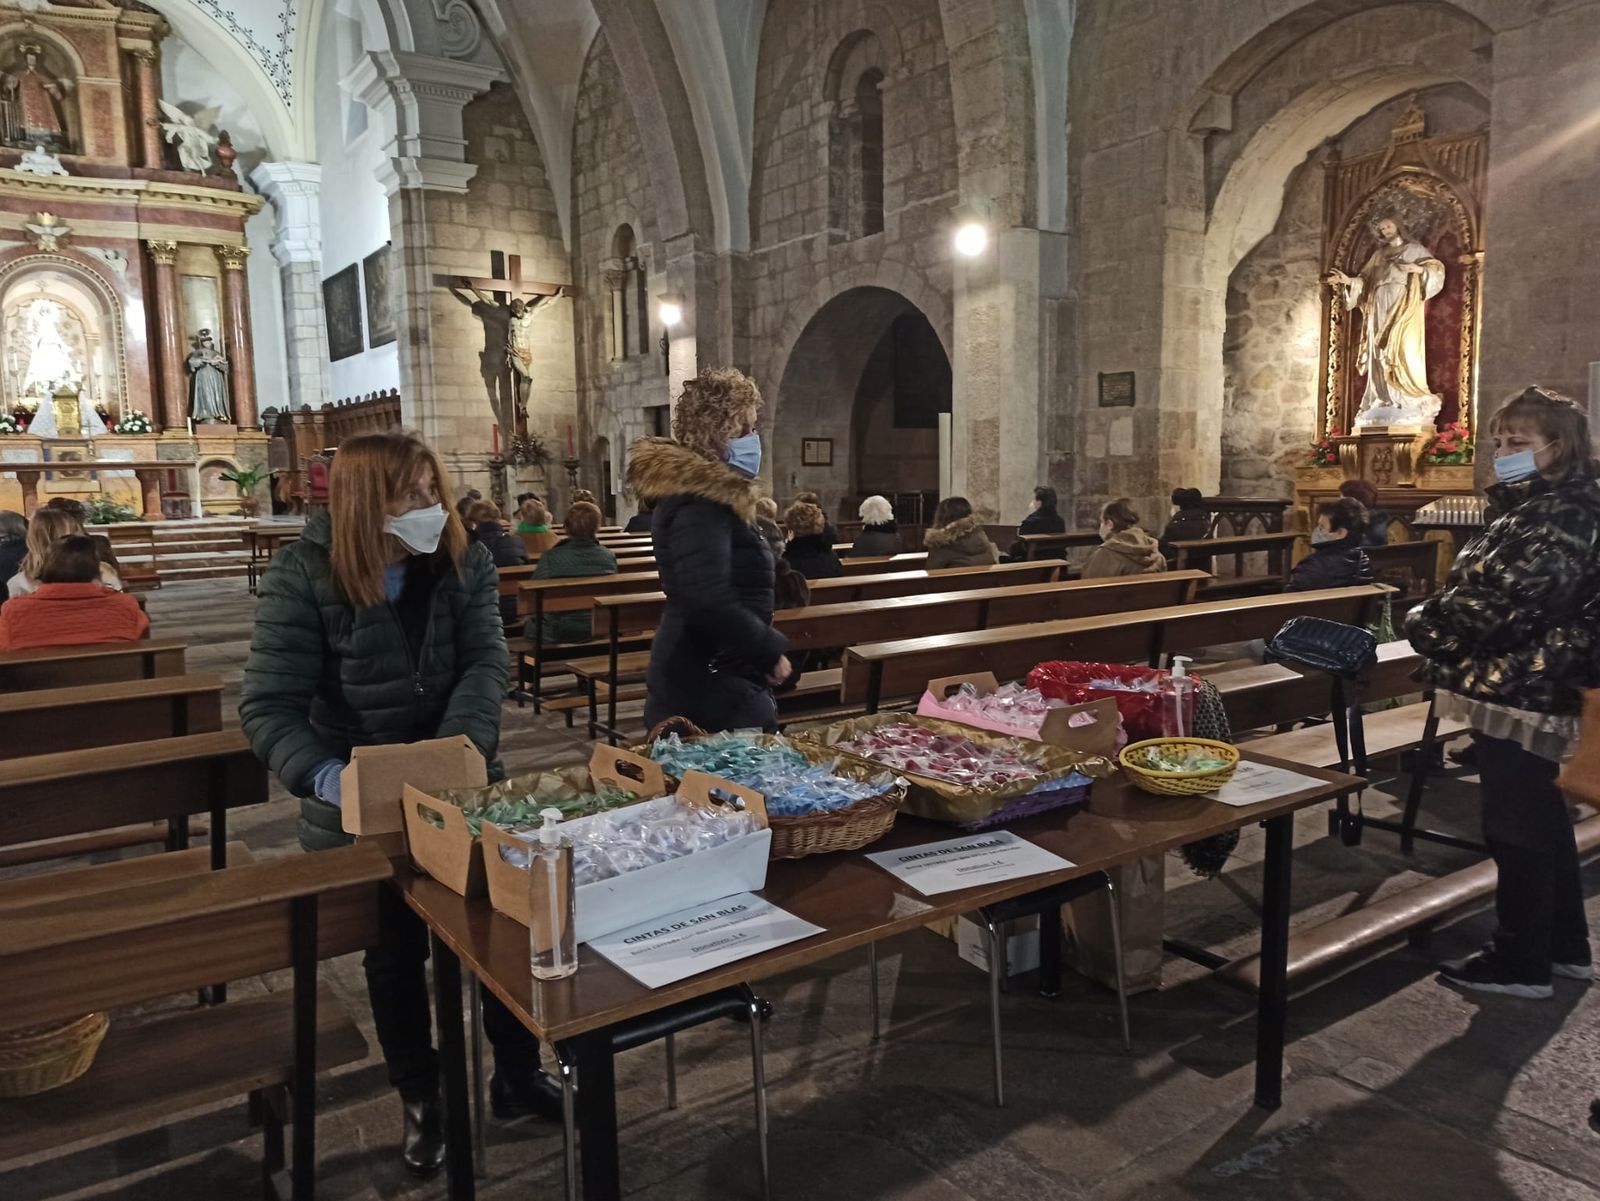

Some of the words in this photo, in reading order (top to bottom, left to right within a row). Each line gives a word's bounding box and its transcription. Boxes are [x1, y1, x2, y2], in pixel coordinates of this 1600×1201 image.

[899, 851, 938, 862] CINTAS
[954, 843, 977, 853] SAN
[977, 839, 1005, 848] BLAS
[624, 927, 670, 944] CINTAS
[671, 921, 688, 930] DE
[690, 913, 716, 924] SAN
[716, 904, 748, 917] BLAS
